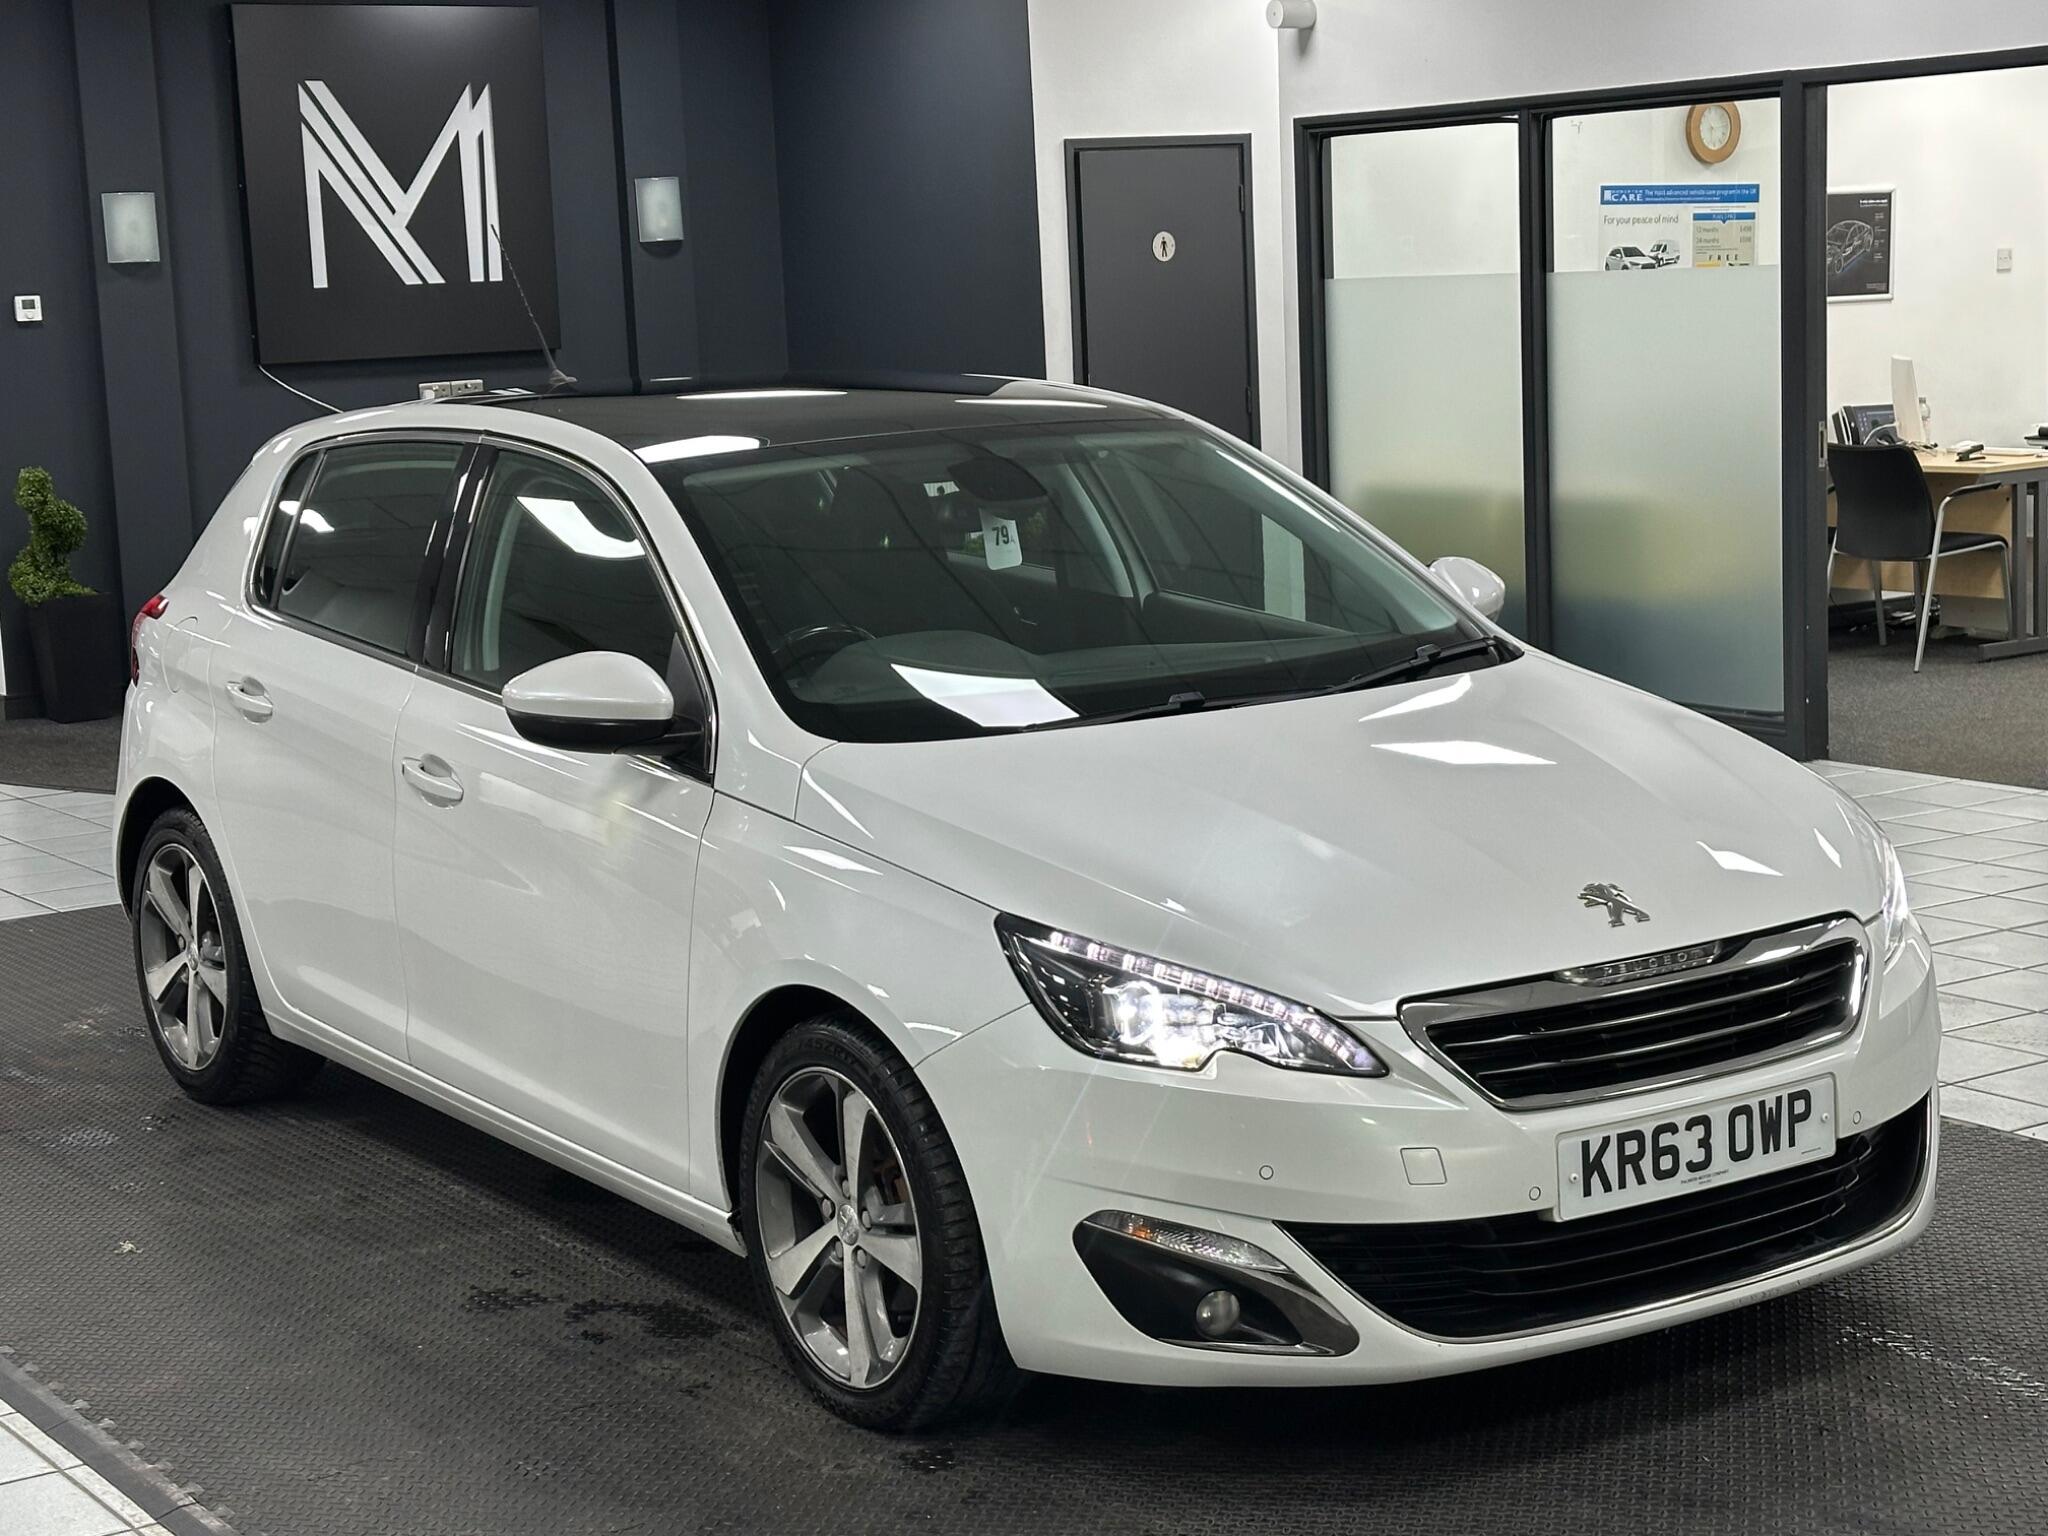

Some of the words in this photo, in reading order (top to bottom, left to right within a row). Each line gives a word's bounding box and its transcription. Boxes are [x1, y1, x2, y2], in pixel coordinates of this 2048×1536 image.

[1611, 193, 1643, 202] CARE
[1603, 215, 1615, 224] For
[1616, 216, 1631, 226] your
[1632, 216, 1652, 226] peace
[1654, 214, 1661, 224] of
[1662, 214, 1679, 224] mind
[1603, 948, 1701, 977] PEUGEOT
[1580, 1113, 1713, 1198] KR63
[1727, 1088, 1812, 1163] OWP
